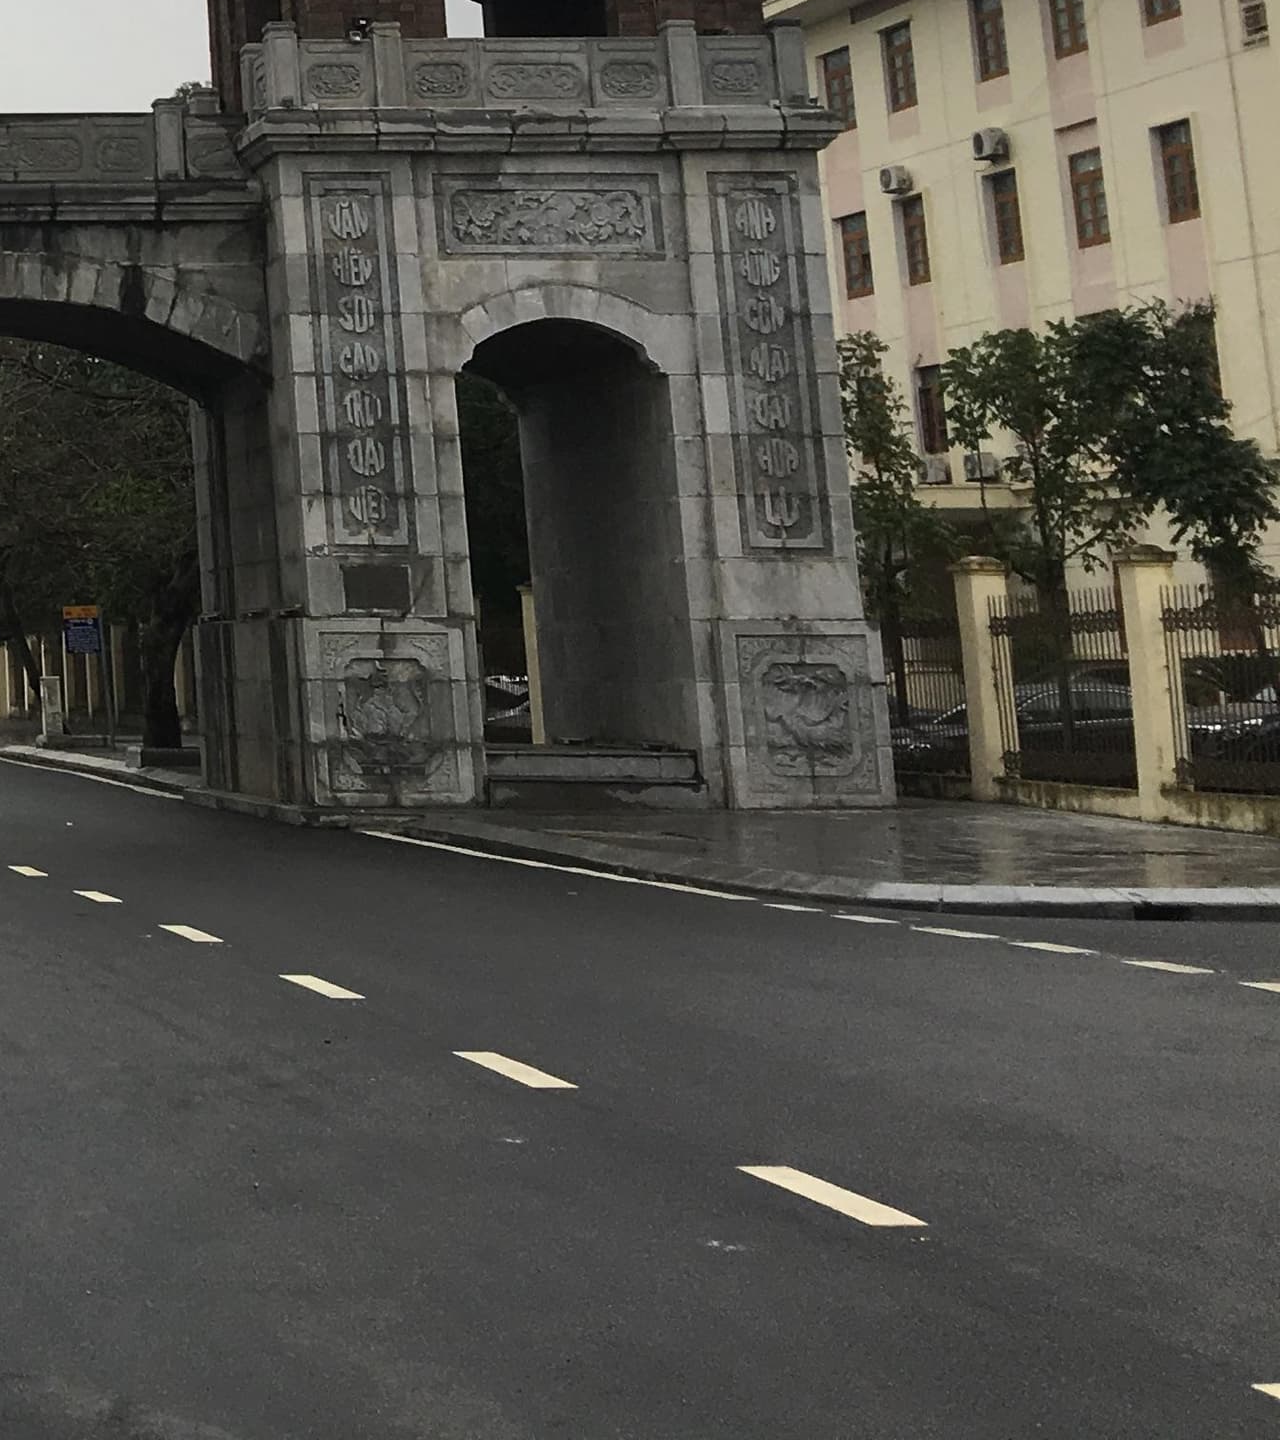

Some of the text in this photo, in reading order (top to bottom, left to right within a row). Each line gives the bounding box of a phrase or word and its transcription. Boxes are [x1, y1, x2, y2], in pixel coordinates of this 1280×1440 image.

[328, 200, 369, 240] VĂN
[735, 200, 777, 241] ANH
[337, 294, 376, 334] SOI
